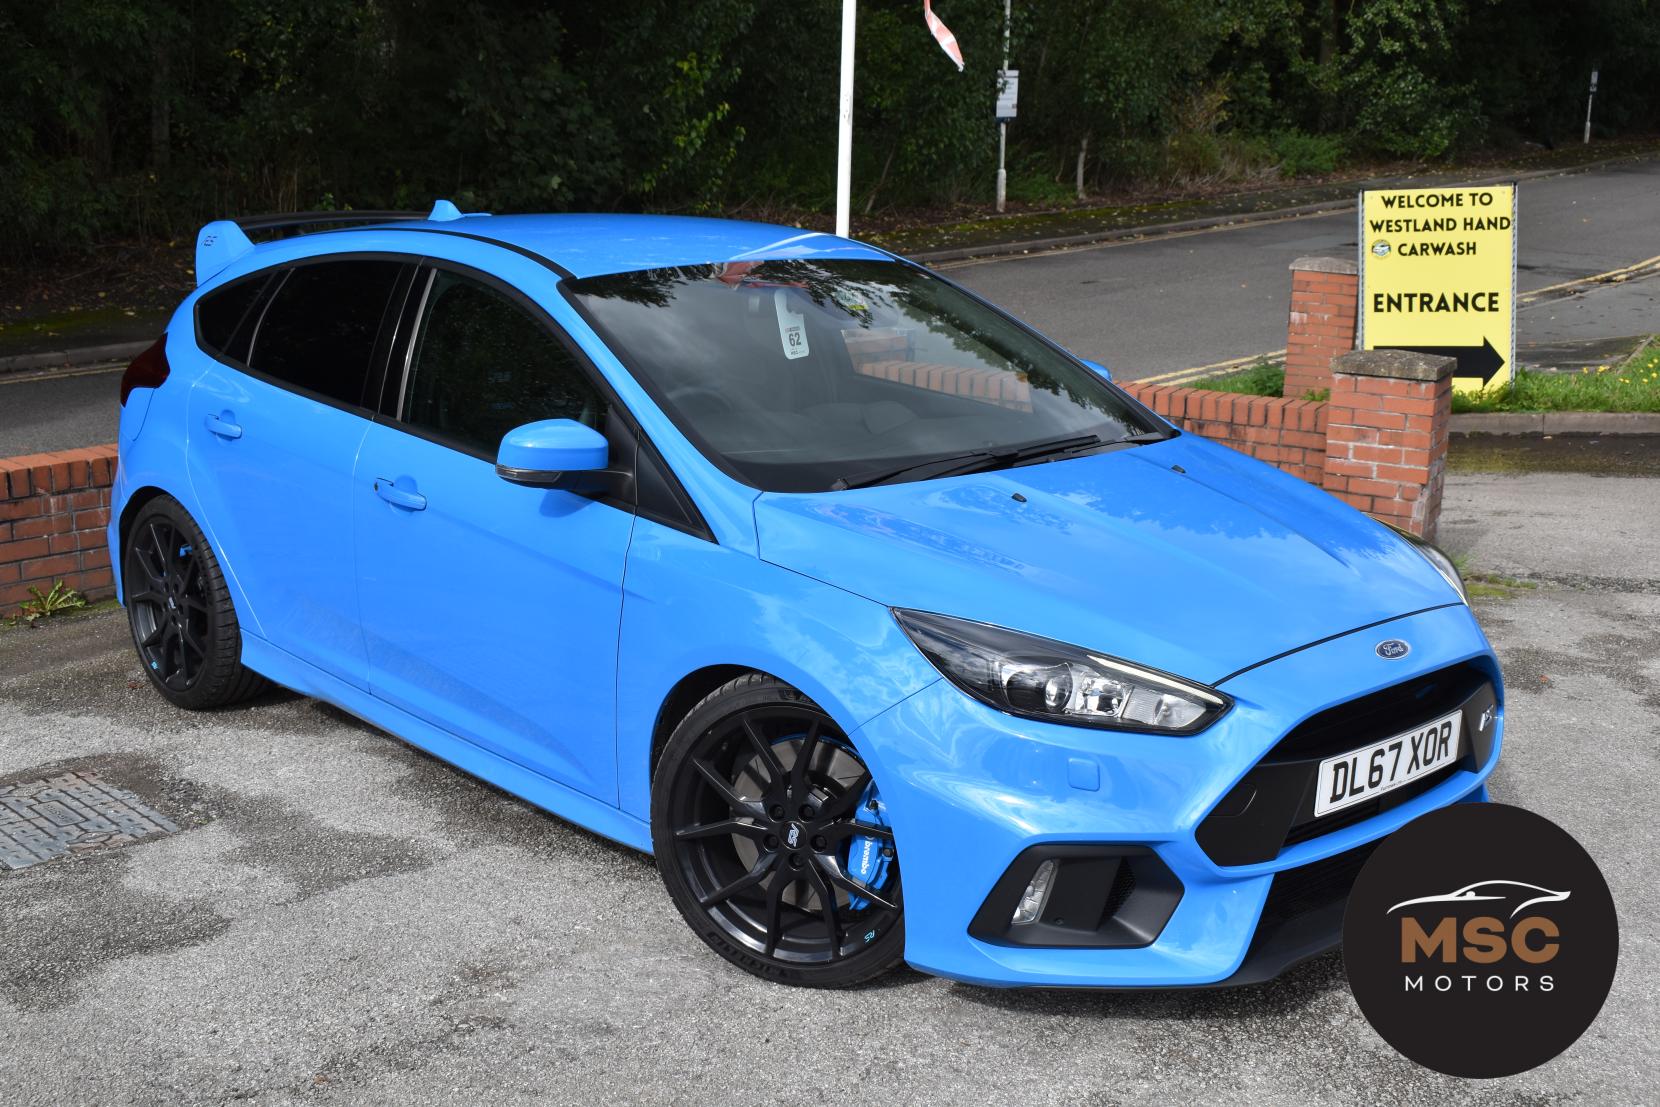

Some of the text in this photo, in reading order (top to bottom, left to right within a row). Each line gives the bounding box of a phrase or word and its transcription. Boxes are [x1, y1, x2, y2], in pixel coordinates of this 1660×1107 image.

[1381, 192, 1493, 208] WELCOME TO
[1369, 217, 1511, 233] WESTLAND HAND
[1398, 242, 1477, 256] CARWASH
[1373, 292, 1499, 313] ENTRANCE
[788, 332, 802, 347] 62
[1383, 643, 1404, 656] Ford
[1329, 720, 1452, 803] DL67 XOR
[861, 840, 873, 875] brembo
